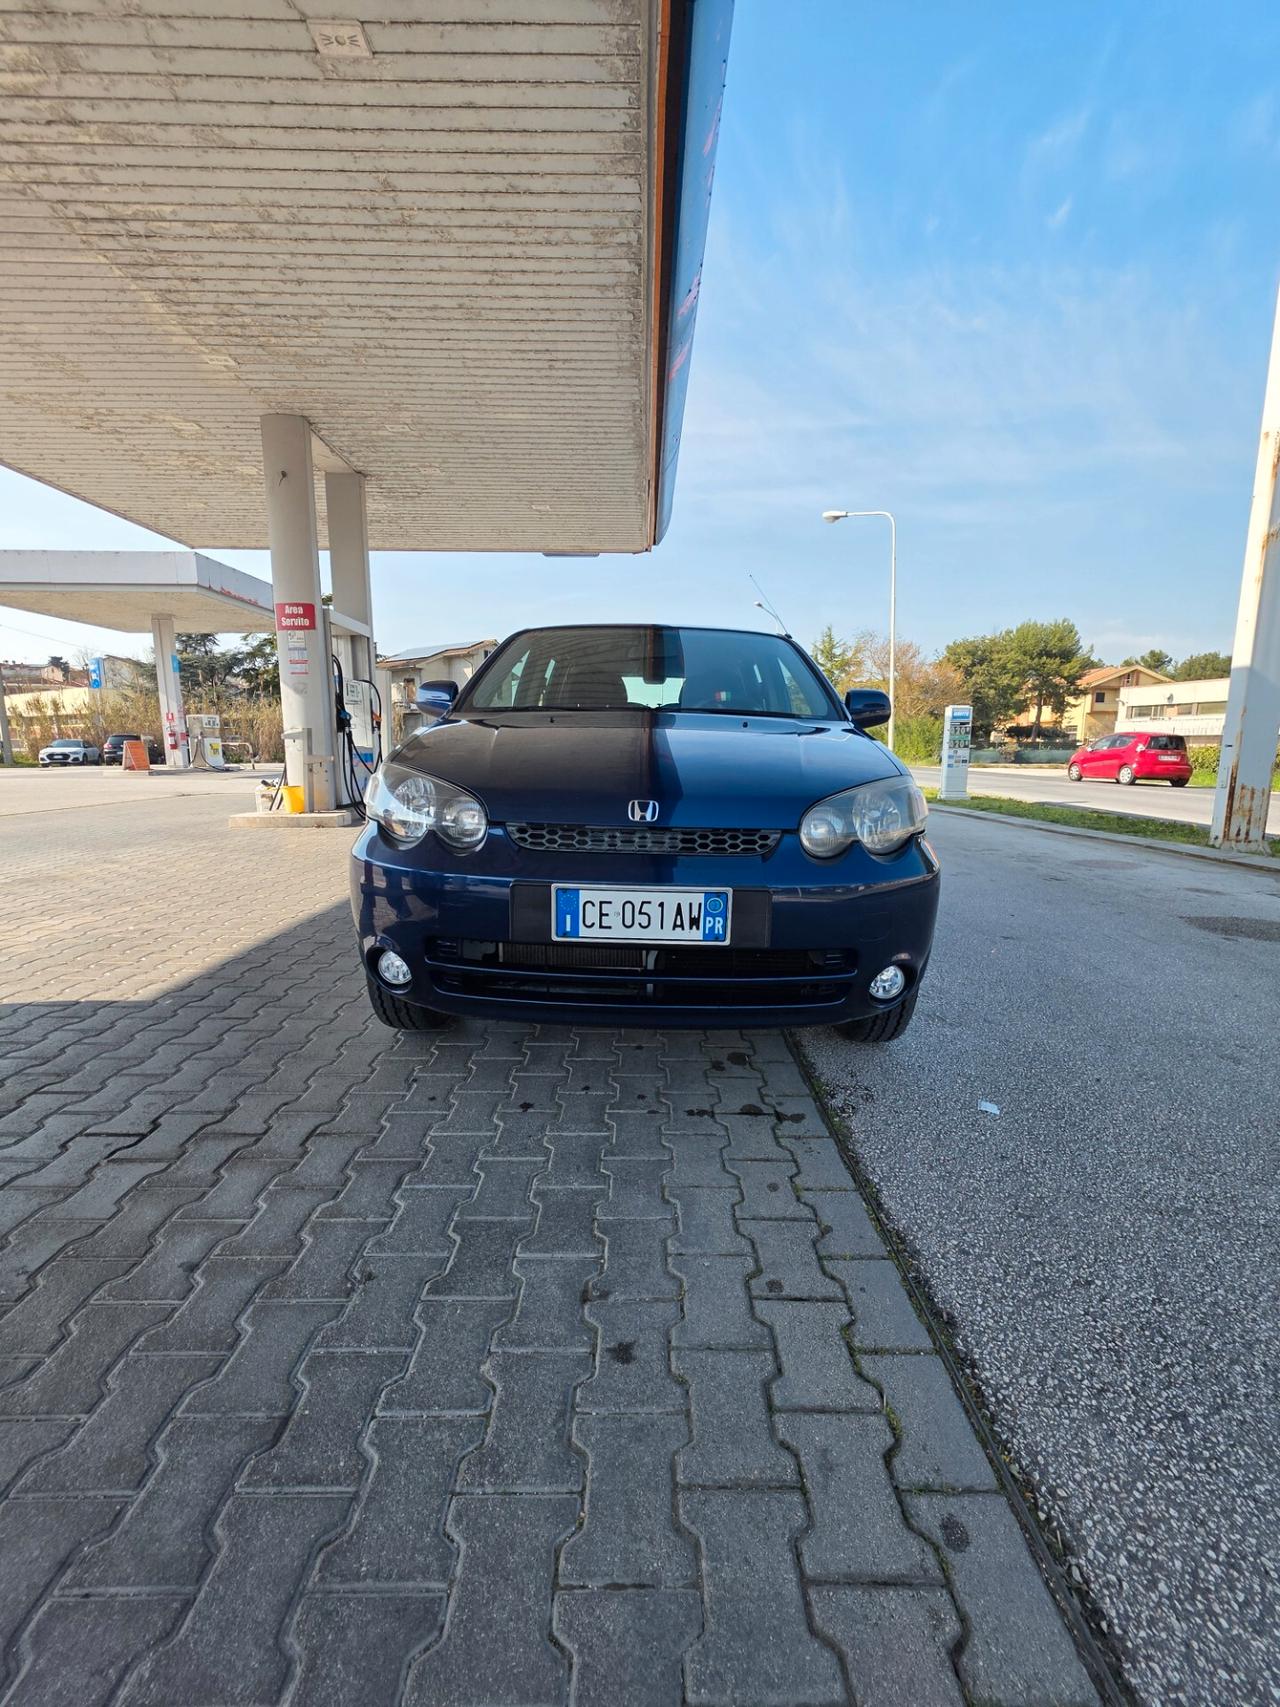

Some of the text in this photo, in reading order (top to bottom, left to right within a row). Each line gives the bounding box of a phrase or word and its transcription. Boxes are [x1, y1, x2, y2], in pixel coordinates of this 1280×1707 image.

[285, 605, 303, 614] Area
[281, 617, 309, 626] Servito
[705, 917, 723, 934] PR
